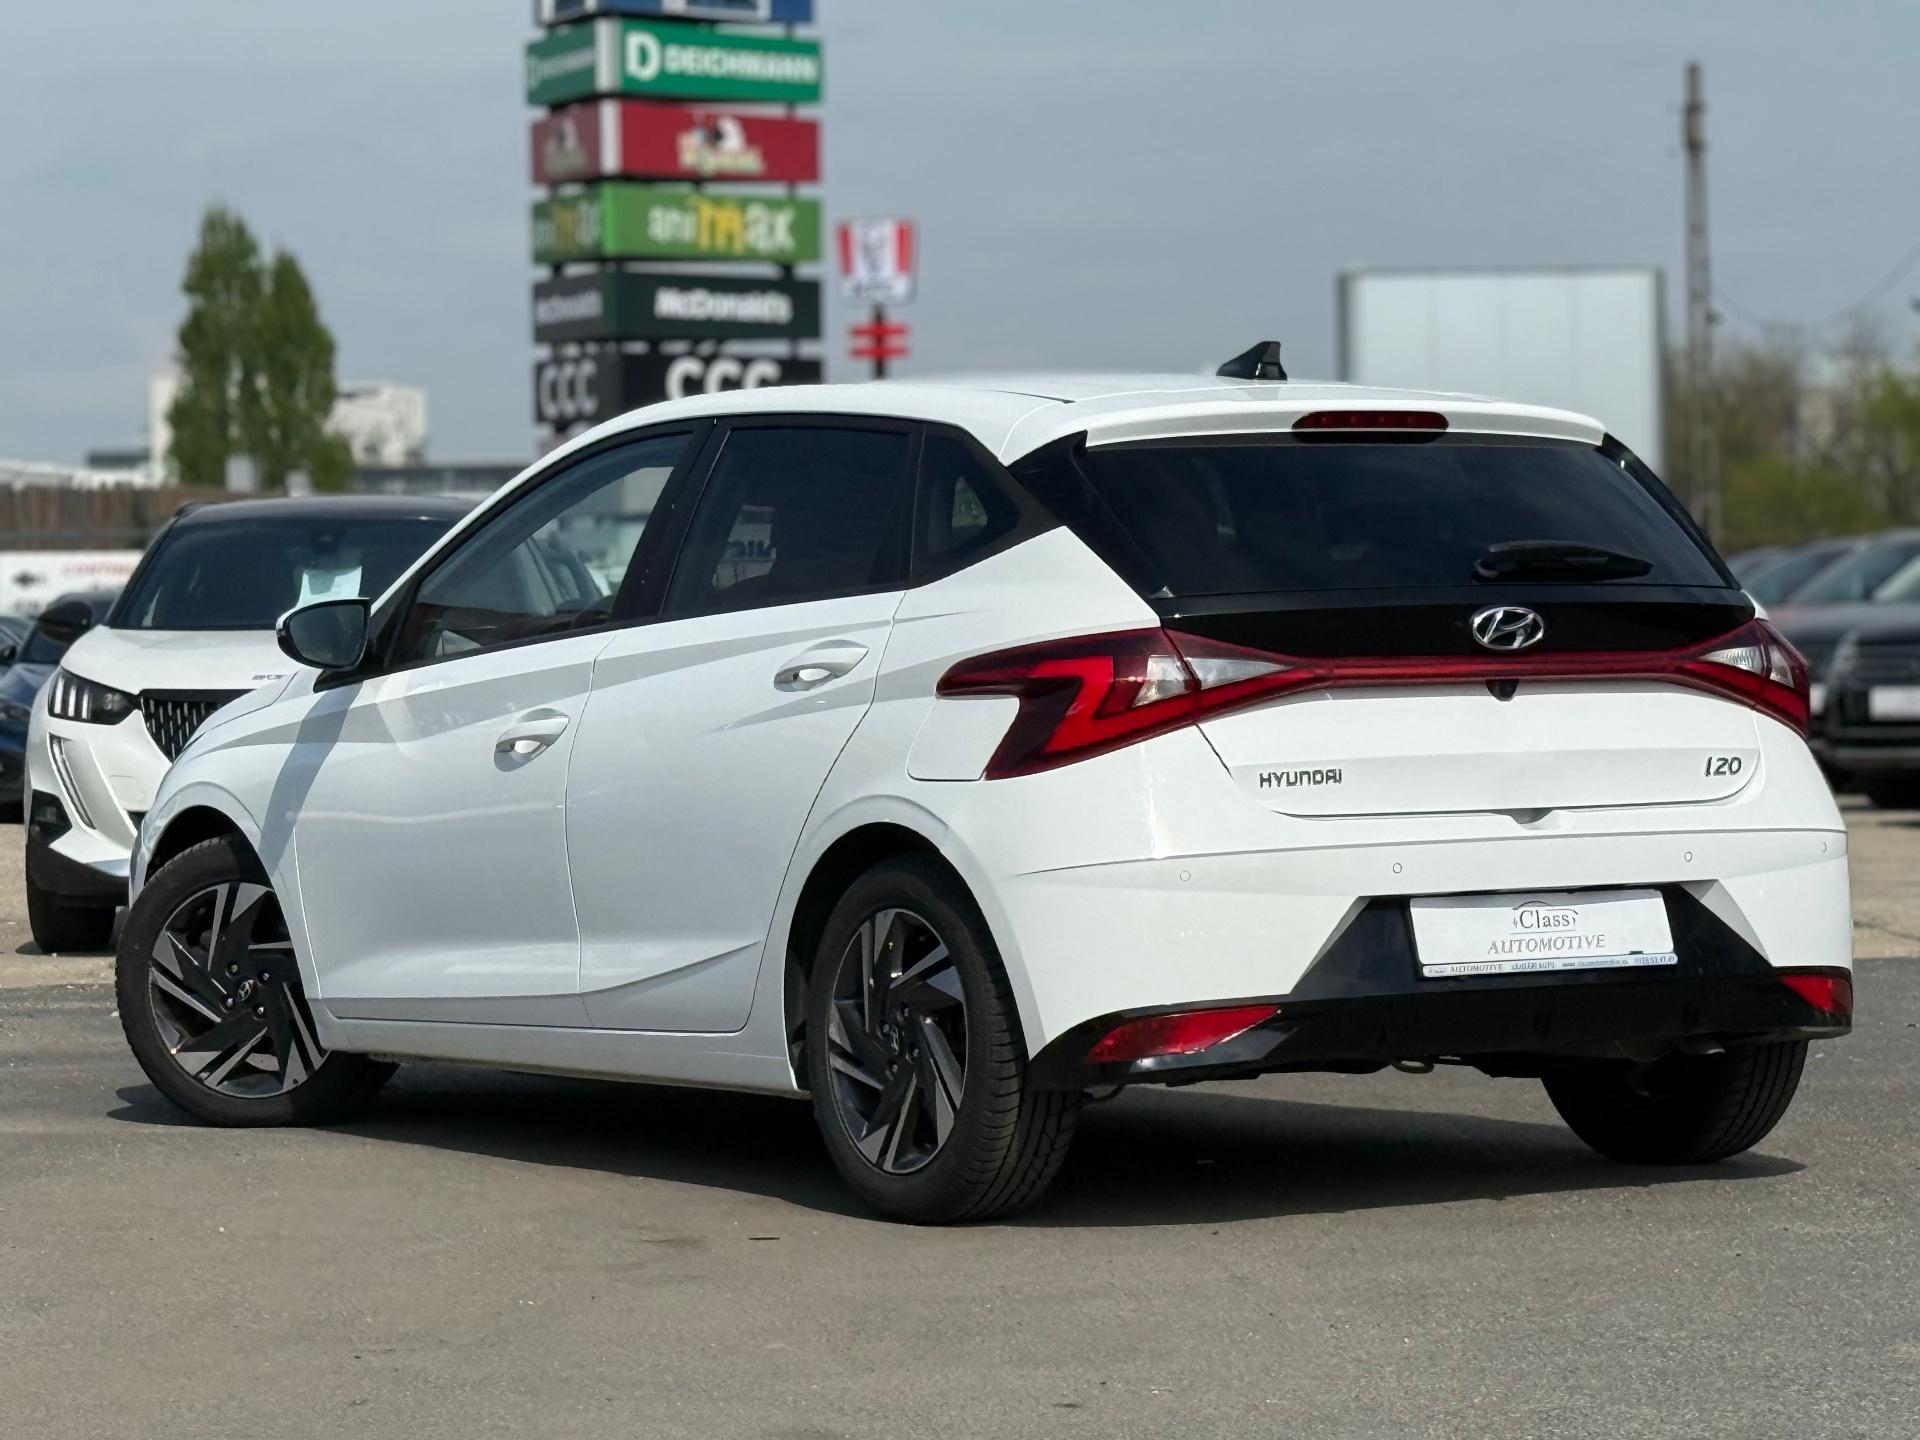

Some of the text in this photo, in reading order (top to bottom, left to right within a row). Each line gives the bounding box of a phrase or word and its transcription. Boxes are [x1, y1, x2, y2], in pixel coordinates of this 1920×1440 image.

[625, 31, 660, 80] D
[647, 197, 795, 253] animax
[1259, 768, 1343, 789] HYUNDAI
[1518, 909, 1571, 930] Class
[1487, 933, 1607, 956] AUTOMOTIVE
